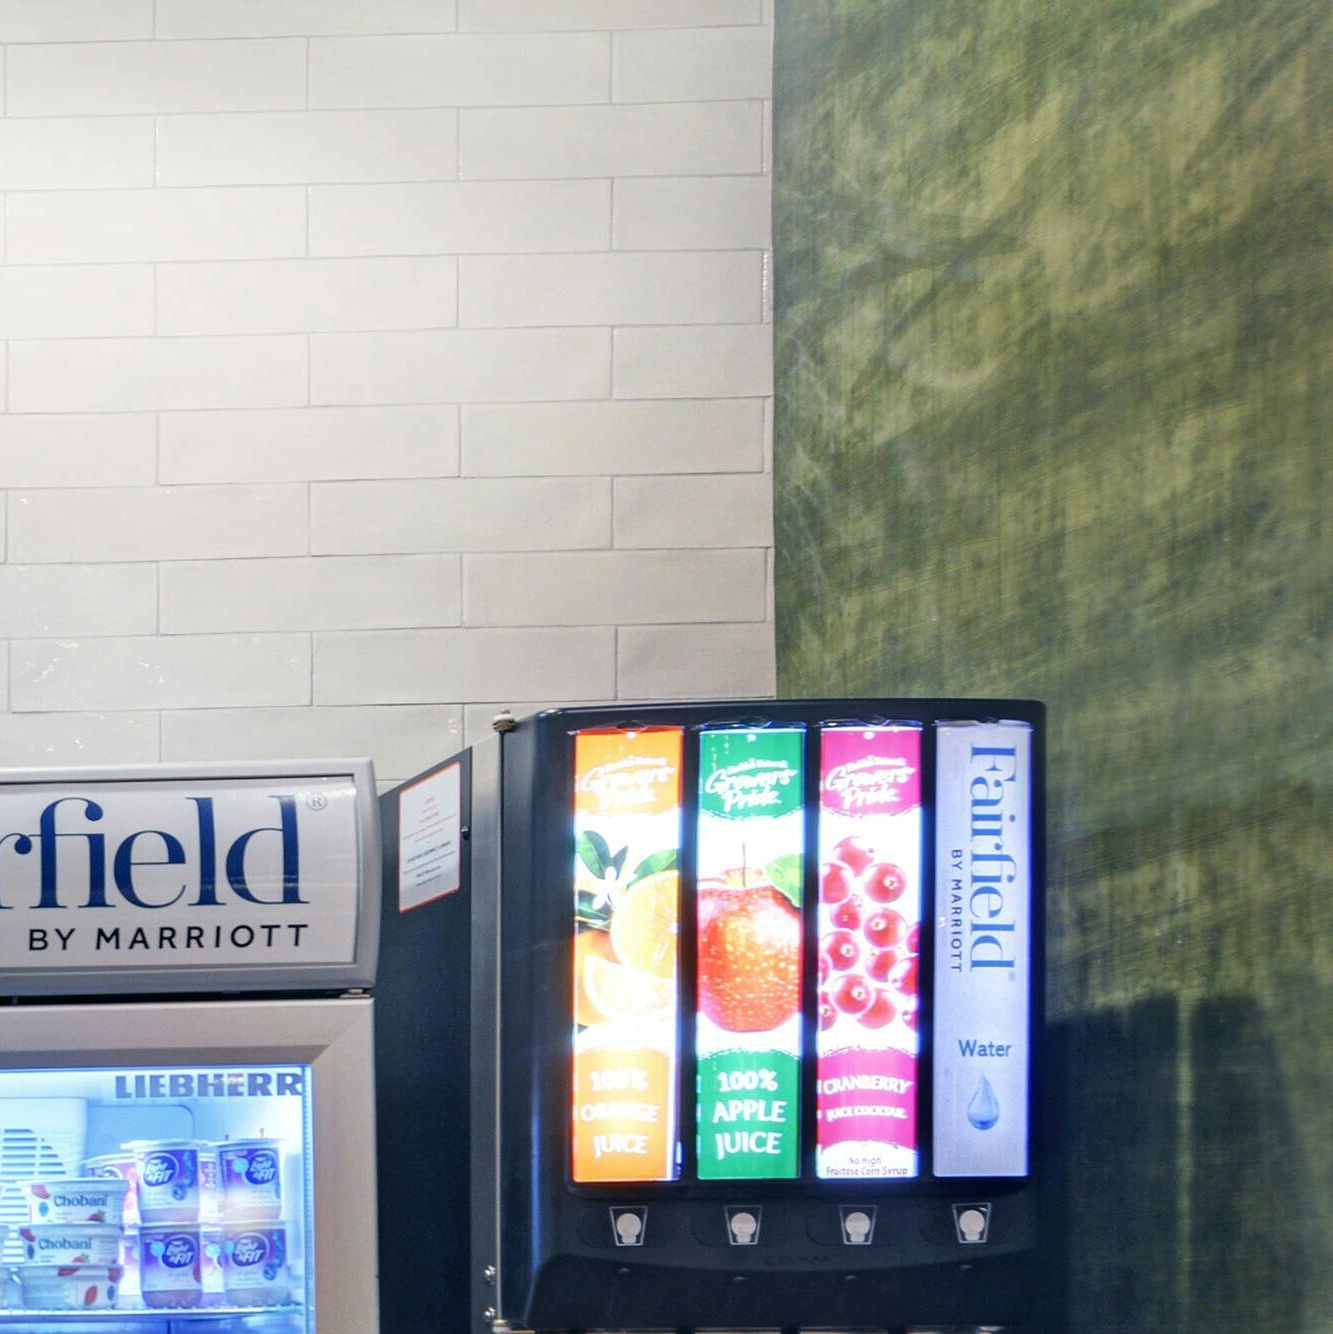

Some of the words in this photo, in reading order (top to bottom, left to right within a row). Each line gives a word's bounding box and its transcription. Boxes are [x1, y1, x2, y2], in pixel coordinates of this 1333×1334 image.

[951, 849, 963, 871] BY
[969, 745, 1017, 972] Fairfield
[28, 928, 76, 951] BY
[95, 924, 309, 950] MARRIOTT
[951, 878, 963, 973] MARRIOTT
[957, 1039, 1012, 1057] Water
[115, 1073, 303, 1099] LIEBHERR
[716, 1068, 779, 1093] 100%
[823, 1073, 914, 1096] CRANBERRY
[712, 1099, 788, 1124] APPLE
[593, 1133, 649, 1159] JUICE
[715, 1131, 782, 1160] JUICE
[54, 1194, 109, 1207] Chobani
[38, 1237, 93, 1250] Chobani
